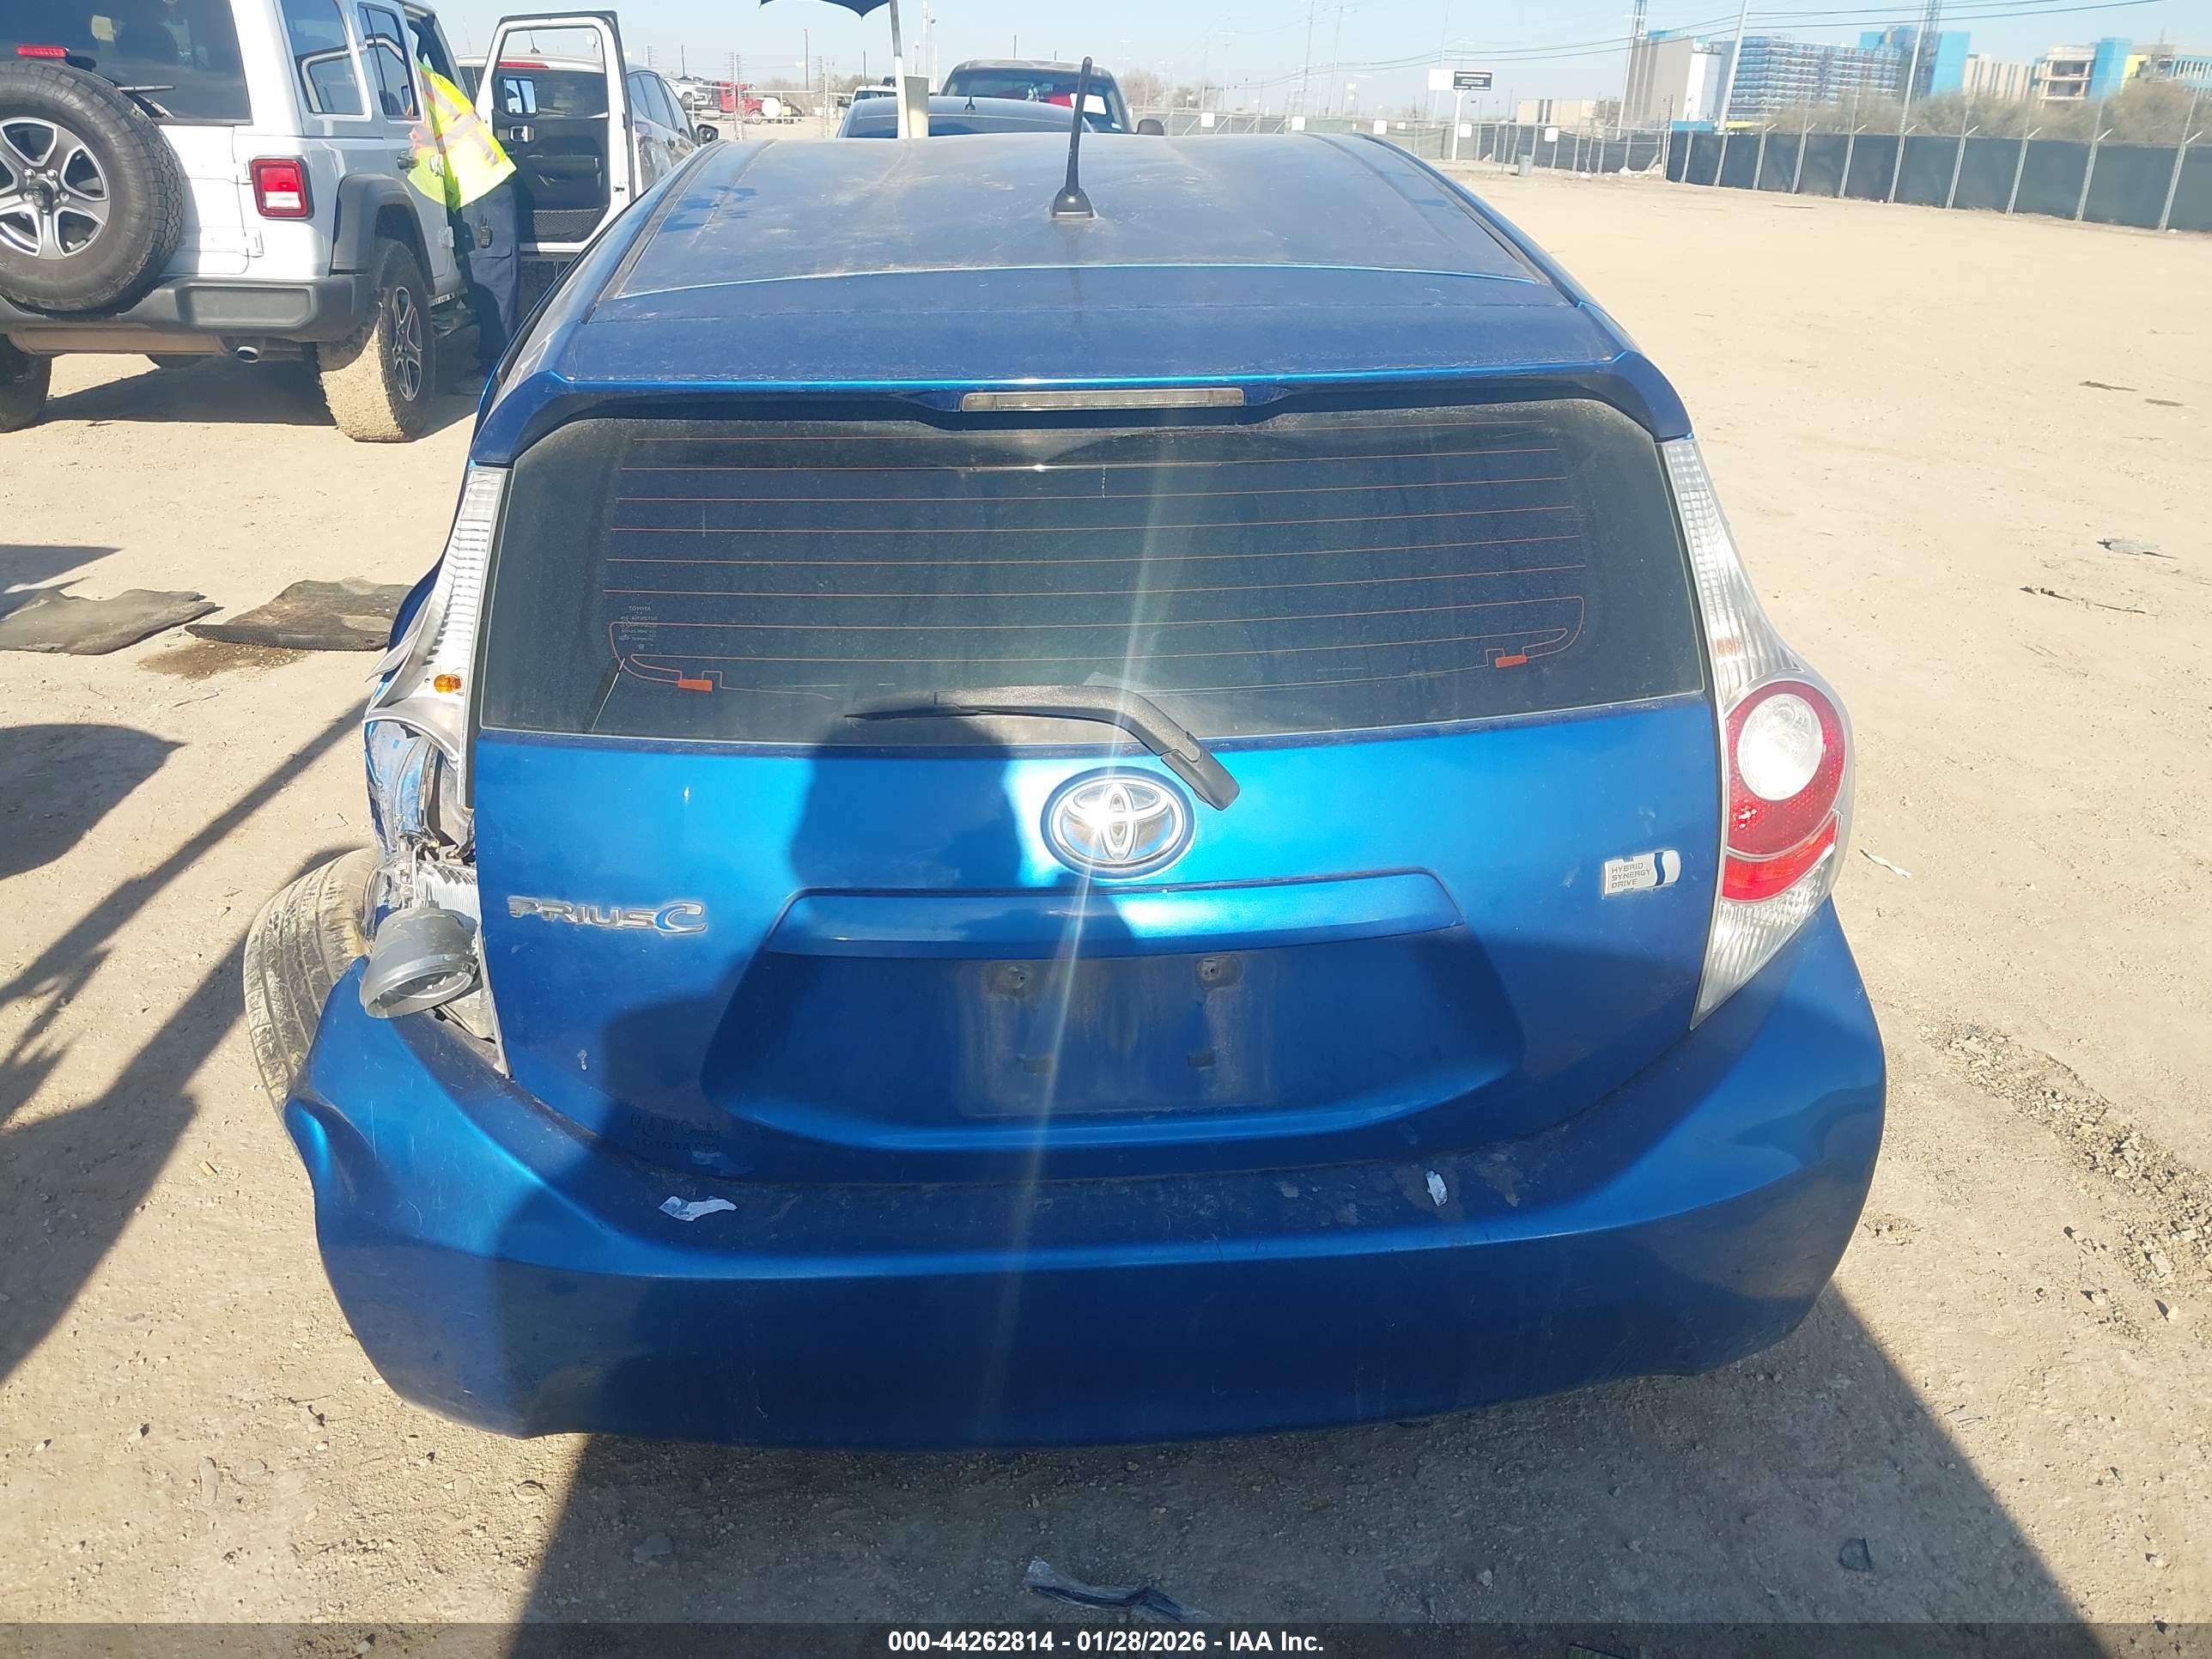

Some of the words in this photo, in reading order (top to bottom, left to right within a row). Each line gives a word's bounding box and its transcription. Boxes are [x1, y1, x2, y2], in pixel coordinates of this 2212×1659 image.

[1611, 862, 1644, 874] HYBRID
[1611, 868, 1651, 881] SYNERGY
[1611, 878, 1638, 889] DRIVE
[507, 896, 655, 930] PRIUS
